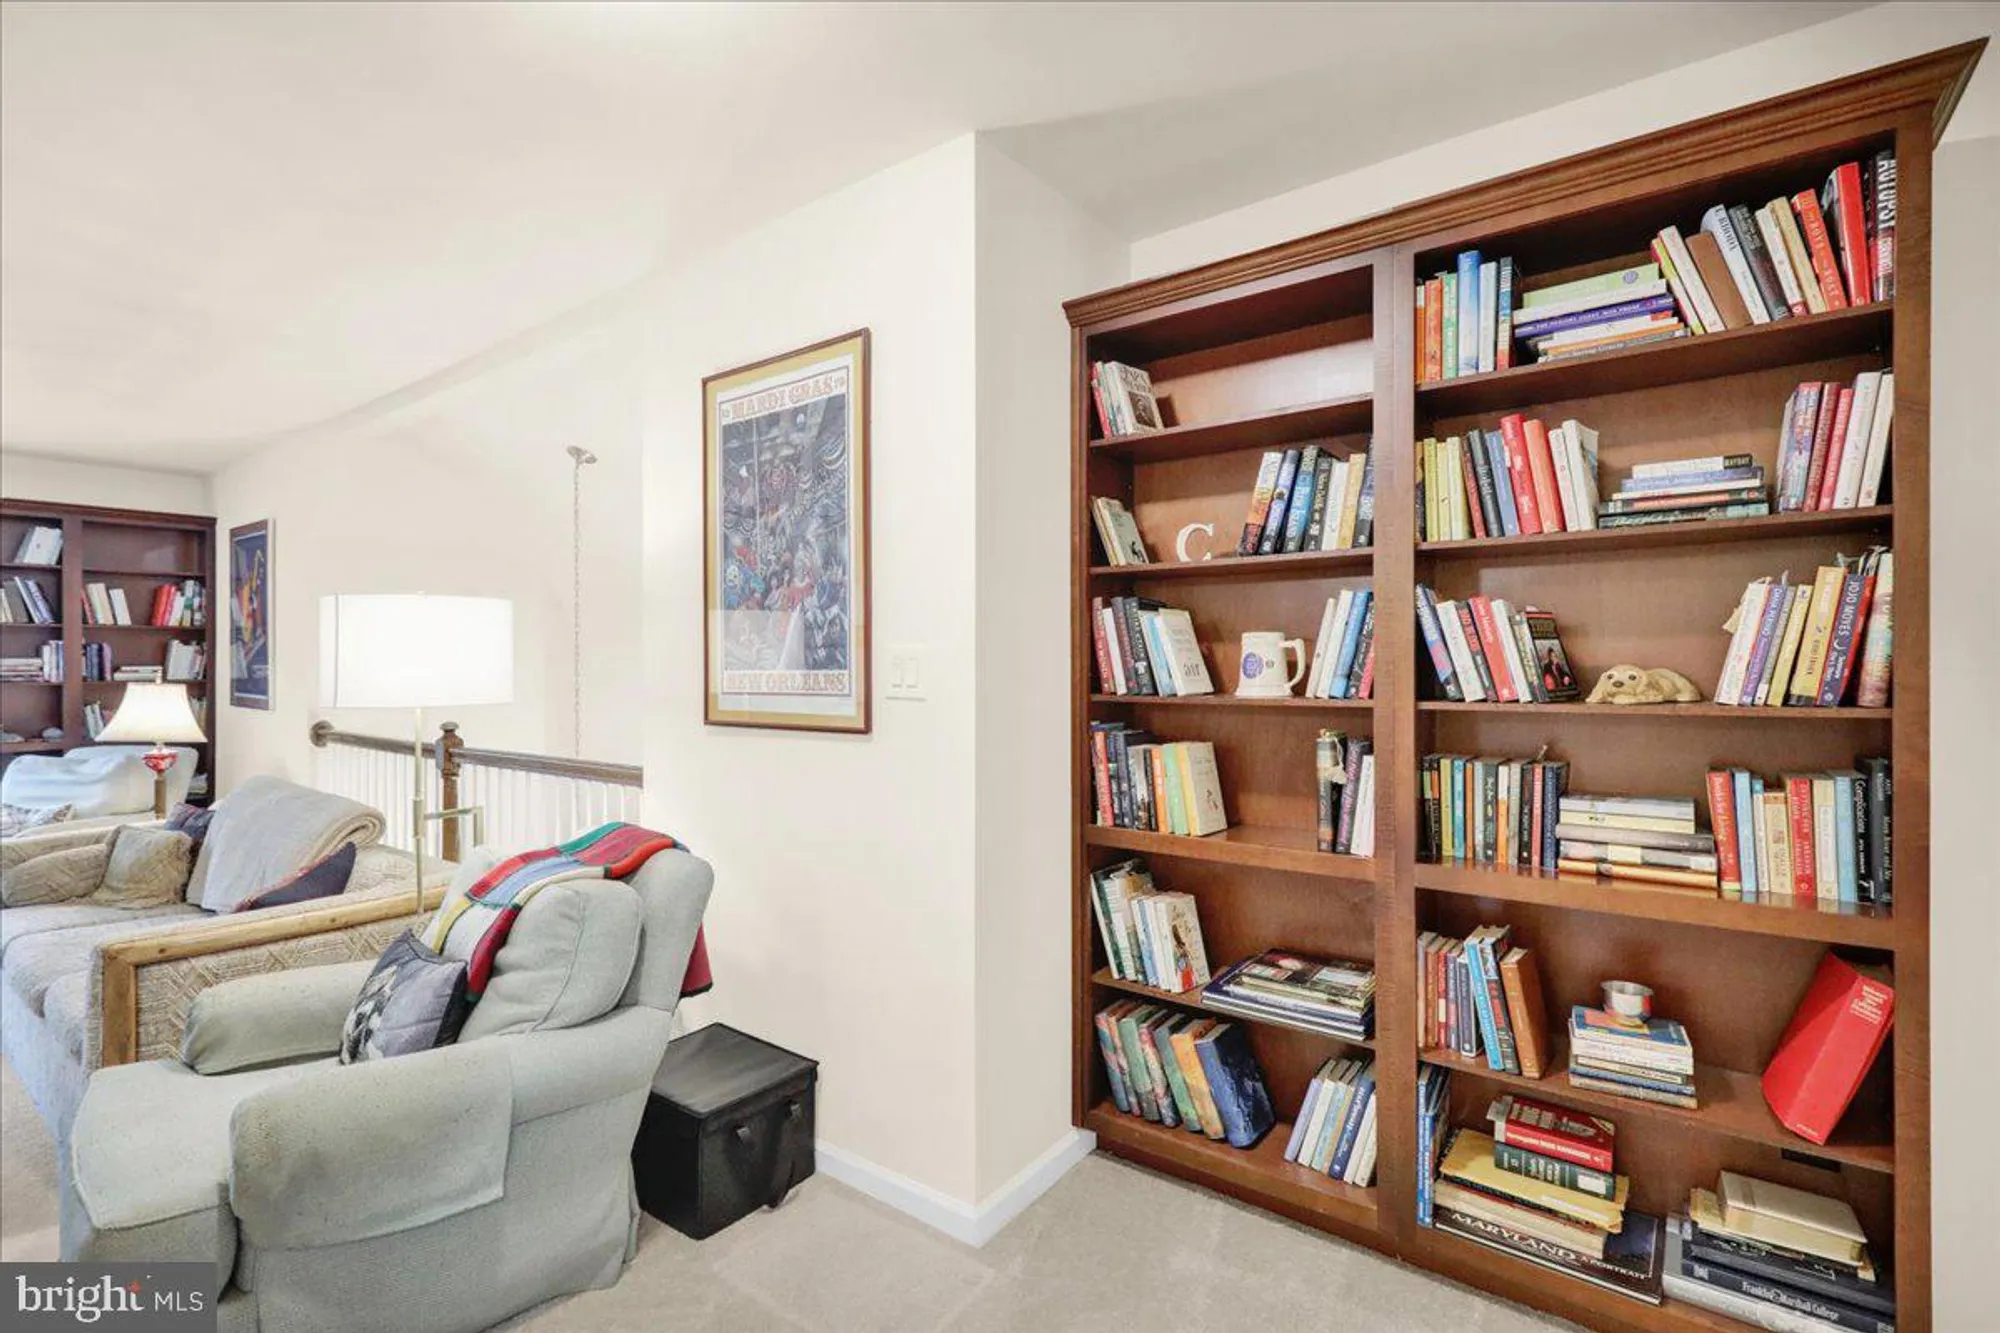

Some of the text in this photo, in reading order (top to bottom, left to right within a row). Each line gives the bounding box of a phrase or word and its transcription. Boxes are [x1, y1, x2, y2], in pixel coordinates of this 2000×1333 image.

[1878, 159, 1897, 231] AUTOPSY
[733, 374, 833, 421] MARDI GRAS
[1176, 523, 1214, 562] C
[1838, 581, 1859, 636] JOJO MOYES
[725, 672, 846, 692] NEW ORLEANS
[1854, 780, 1867, 833] Complications
[1451, 1212, 1577, 1260] MARYLAND
[1589, 1260, 1648, 1281] PORTRAIT
[1812, 1302, 1840, 1322] College
